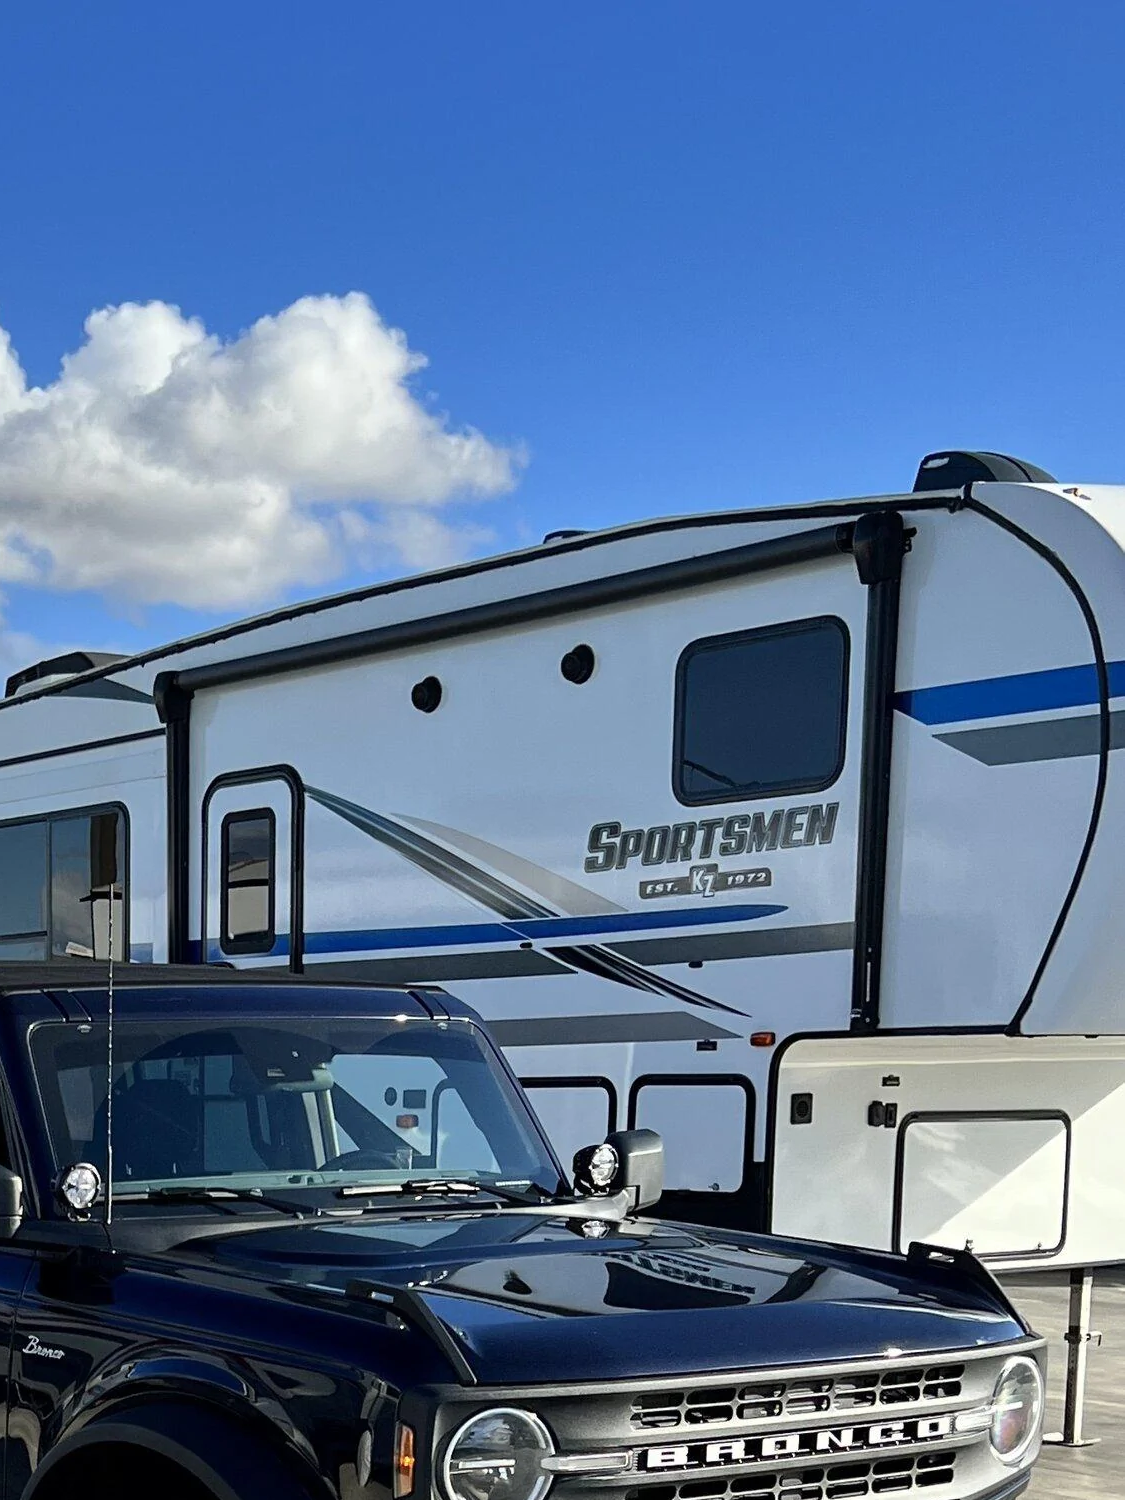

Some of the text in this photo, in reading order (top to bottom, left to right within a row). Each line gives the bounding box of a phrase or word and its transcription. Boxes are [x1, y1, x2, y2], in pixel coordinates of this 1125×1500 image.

[584, 802, 840, 873] SPORTSMEN
[646, 881, 678, 895] EST.
[727, 871, 767, 886] 1972
[22, 1334, 65, 1360] Bronco
[647, 1417, 950, 1468] BRONCO
